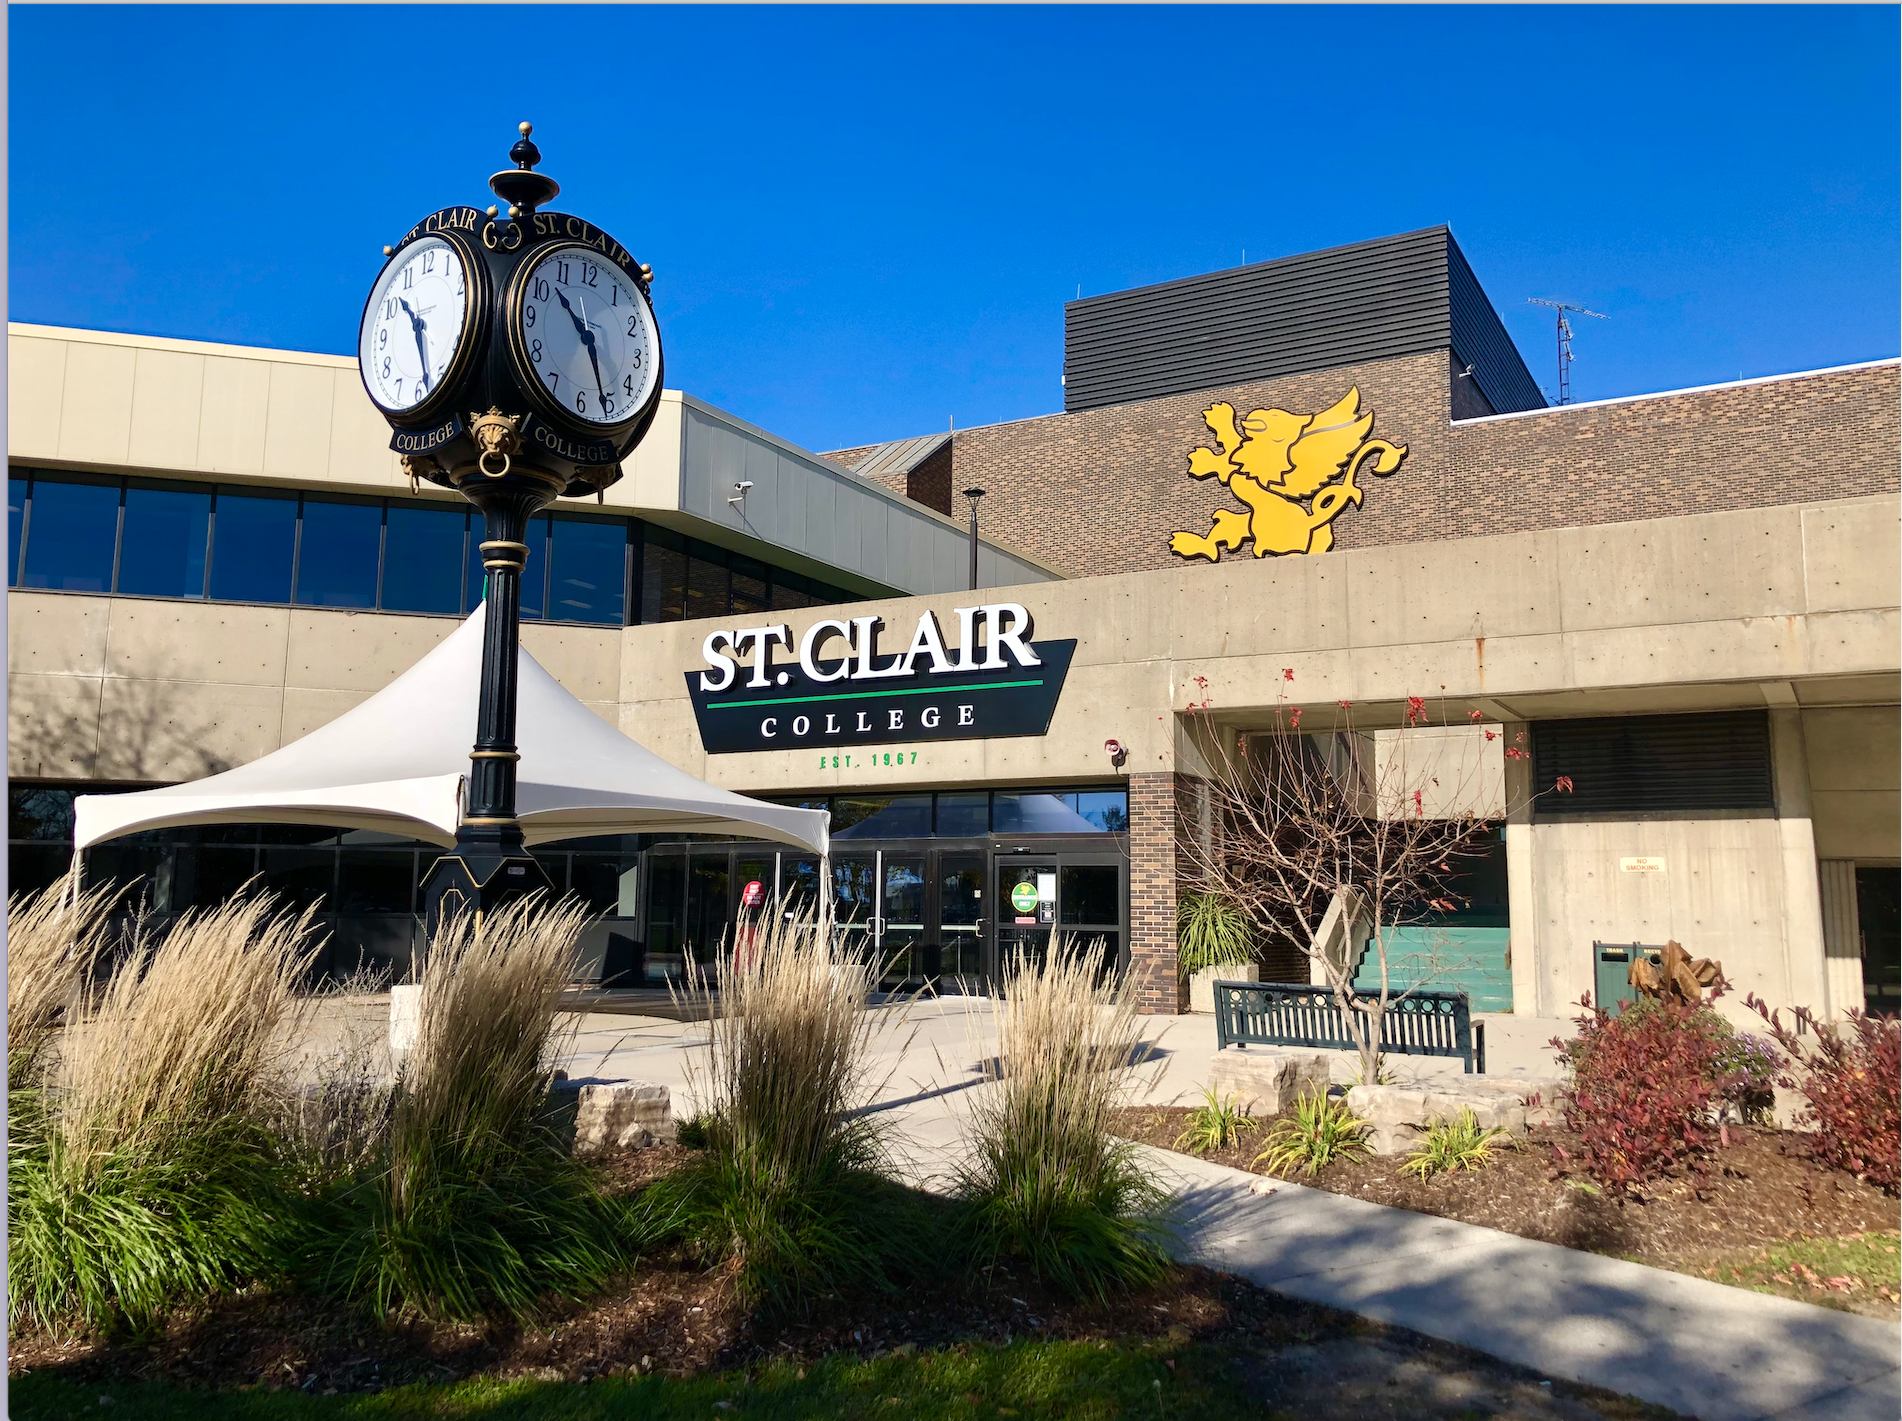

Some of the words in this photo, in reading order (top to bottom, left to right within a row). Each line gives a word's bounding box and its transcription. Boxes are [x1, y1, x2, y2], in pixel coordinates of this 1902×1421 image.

[425, 207, 477, 232] CLAIR
[532, 213, 561, 235] ST.
[565, 217, 631, 267] CLAIR
[421, 250, 435, 275] 12
[444, 253, 451, 277] 1
[556, 260, 569, 286] 11
[403, 266, 414, 291] 11
[457, 272, 465, 296] 2
[581, 262, 598, 288] 12
[532, 276, 550, 302] 10
[611, 284, 618, 307] 1
[386, 296, 398, 321] 10
[526, 305, 536, 328] 9
[627, 315, 638, 338] 2
[379, 328, 388, 351] 9
[531, 338, 543, 363] 8
[382, 356, 391, 379] 8
[633, 348, 642, 370] 3
[393, 377, 403, 401] 7
[415, 380, 423, 403] 6
[547, 371, 559, 397] 7
[622, 373, 634, 397] 4
[576, 390, 586, 414] 6
[604, 391, 616, 414] 5
[396, 421, 455, 451] COLLEGE
[534, 426, 609, 461] COLLEGE
[699, 623, 790, 693] ST.
[799, 602, 1043, 684] CLAIR
[760, 704, 976, 738] COLLEGE
[871, 751, 918, 767] 1967
